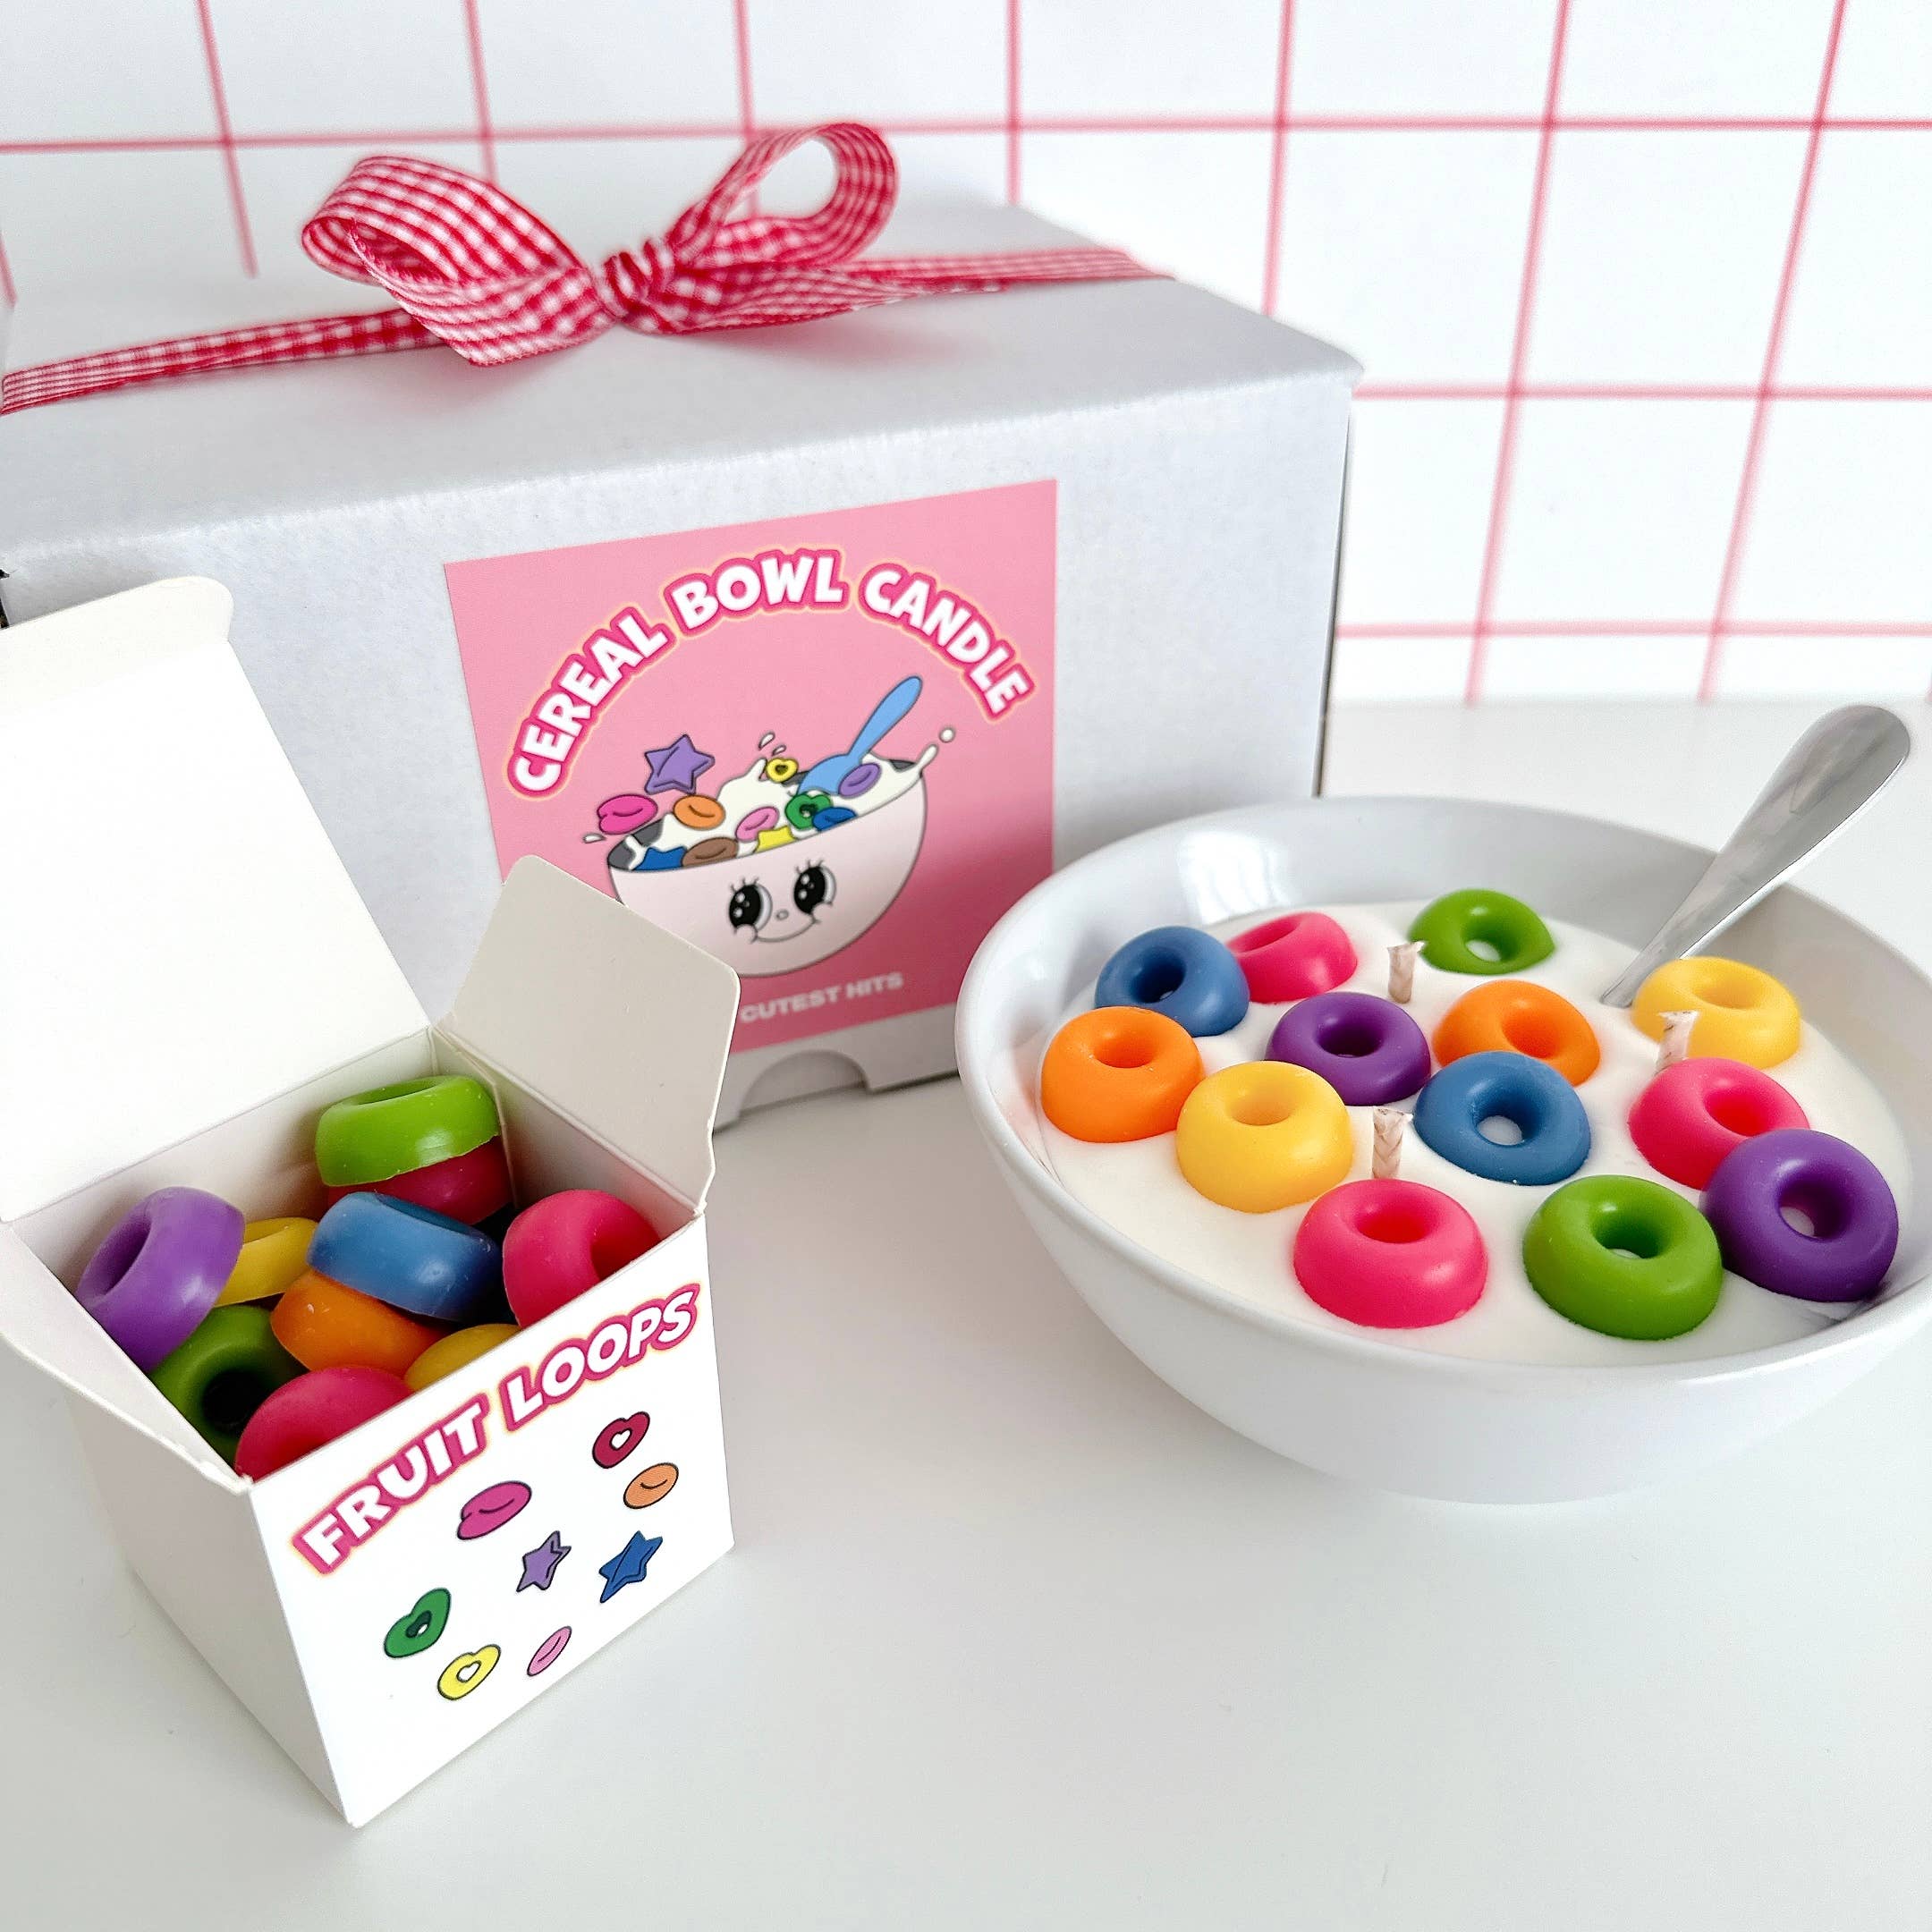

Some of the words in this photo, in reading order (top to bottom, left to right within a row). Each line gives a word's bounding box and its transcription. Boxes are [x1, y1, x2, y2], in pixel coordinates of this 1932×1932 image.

[510, 611, 673, 795] CEREAL
[668, 551, 845, 632] BOWL
[862, 568, 1030, 717] CANDLE
[740, 986, 842, 1022] CUTEST
[845, 971, 904, 1000] HITS
[299, 1399, 485, 1569] FRUIT
[502, 1288, 698, 1425] LOOPS
